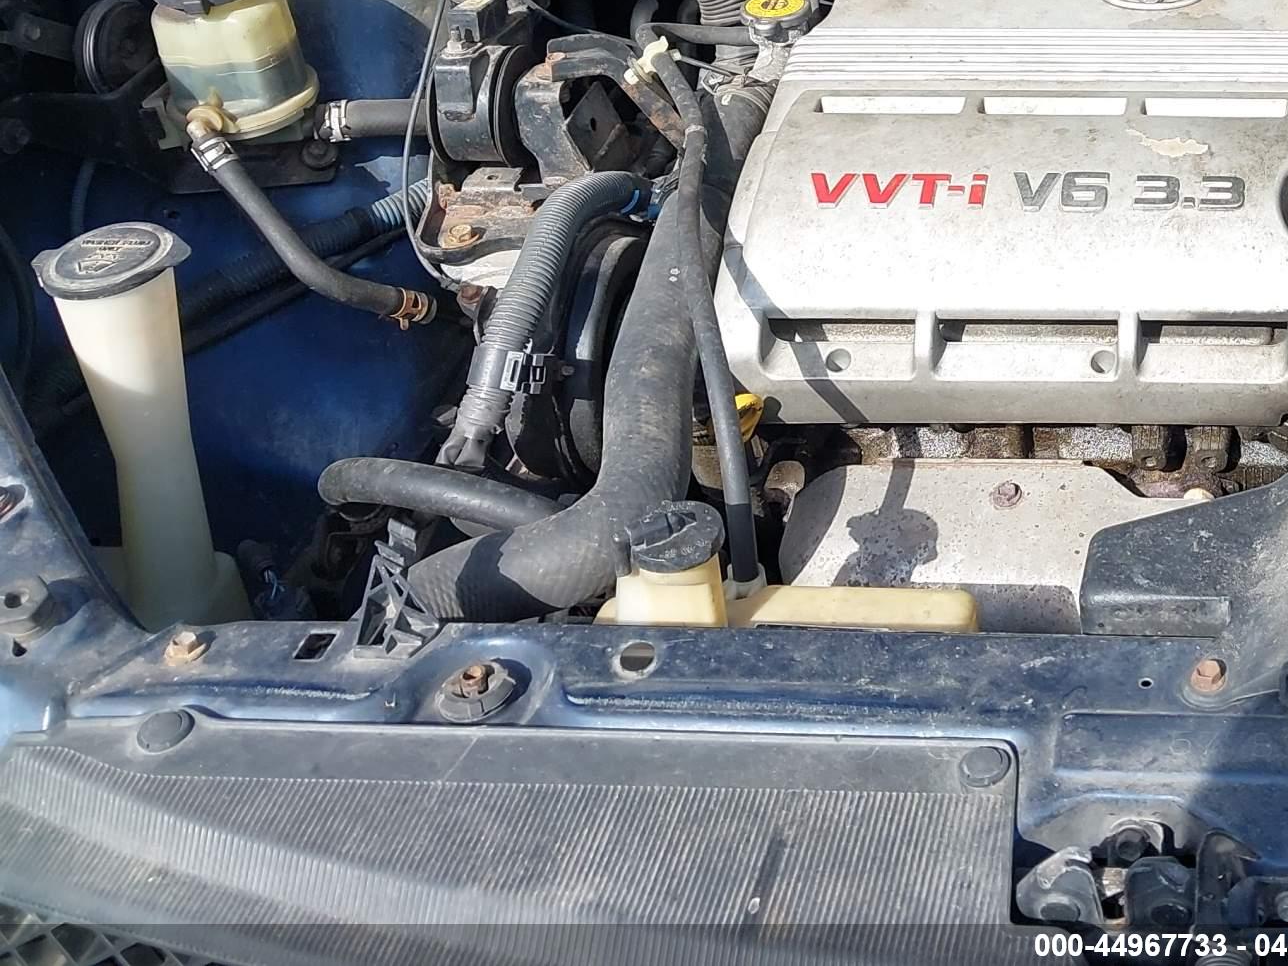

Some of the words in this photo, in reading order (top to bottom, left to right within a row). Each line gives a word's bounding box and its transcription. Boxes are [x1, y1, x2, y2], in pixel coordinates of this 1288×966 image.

[810, 171, 989, 210] VVT-i
[1013, 171, 1111, 212] V6
[1133, 174, 1247, 211] 3.3
